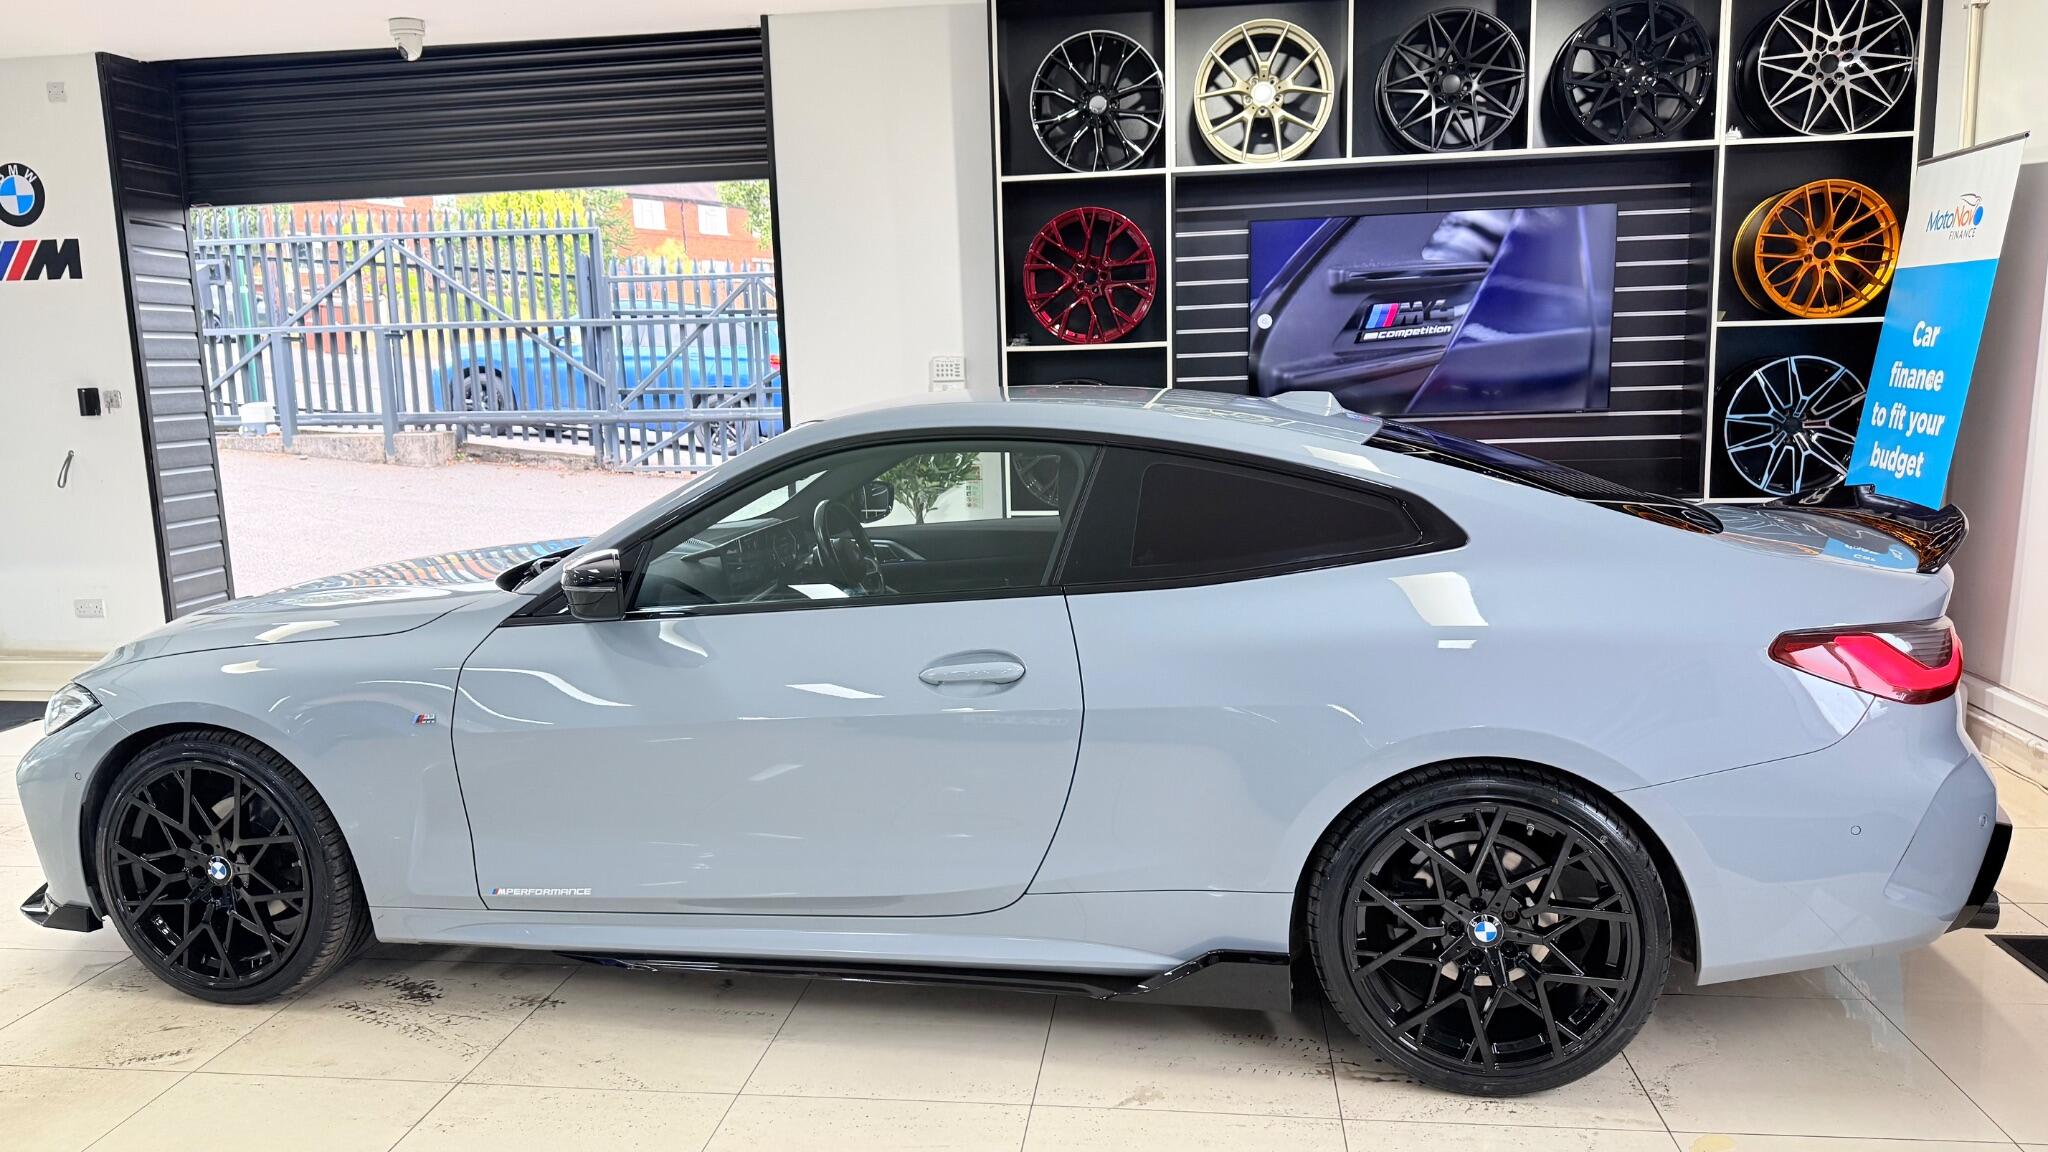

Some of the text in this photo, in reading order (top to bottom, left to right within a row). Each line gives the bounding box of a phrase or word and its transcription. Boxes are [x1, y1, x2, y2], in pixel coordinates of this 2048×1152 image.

[0, 164, 37, 184] MW
[1949, 227, 1976, 240] FINANCE
[1377, 325, 1453, 340] competition
[1912, 320, 1941, 347] Car
[1888, 360, 1944, 391] finance
[1871, 401, 1946, 437] to fit your
[1869, 441, 1925, 479] budget
